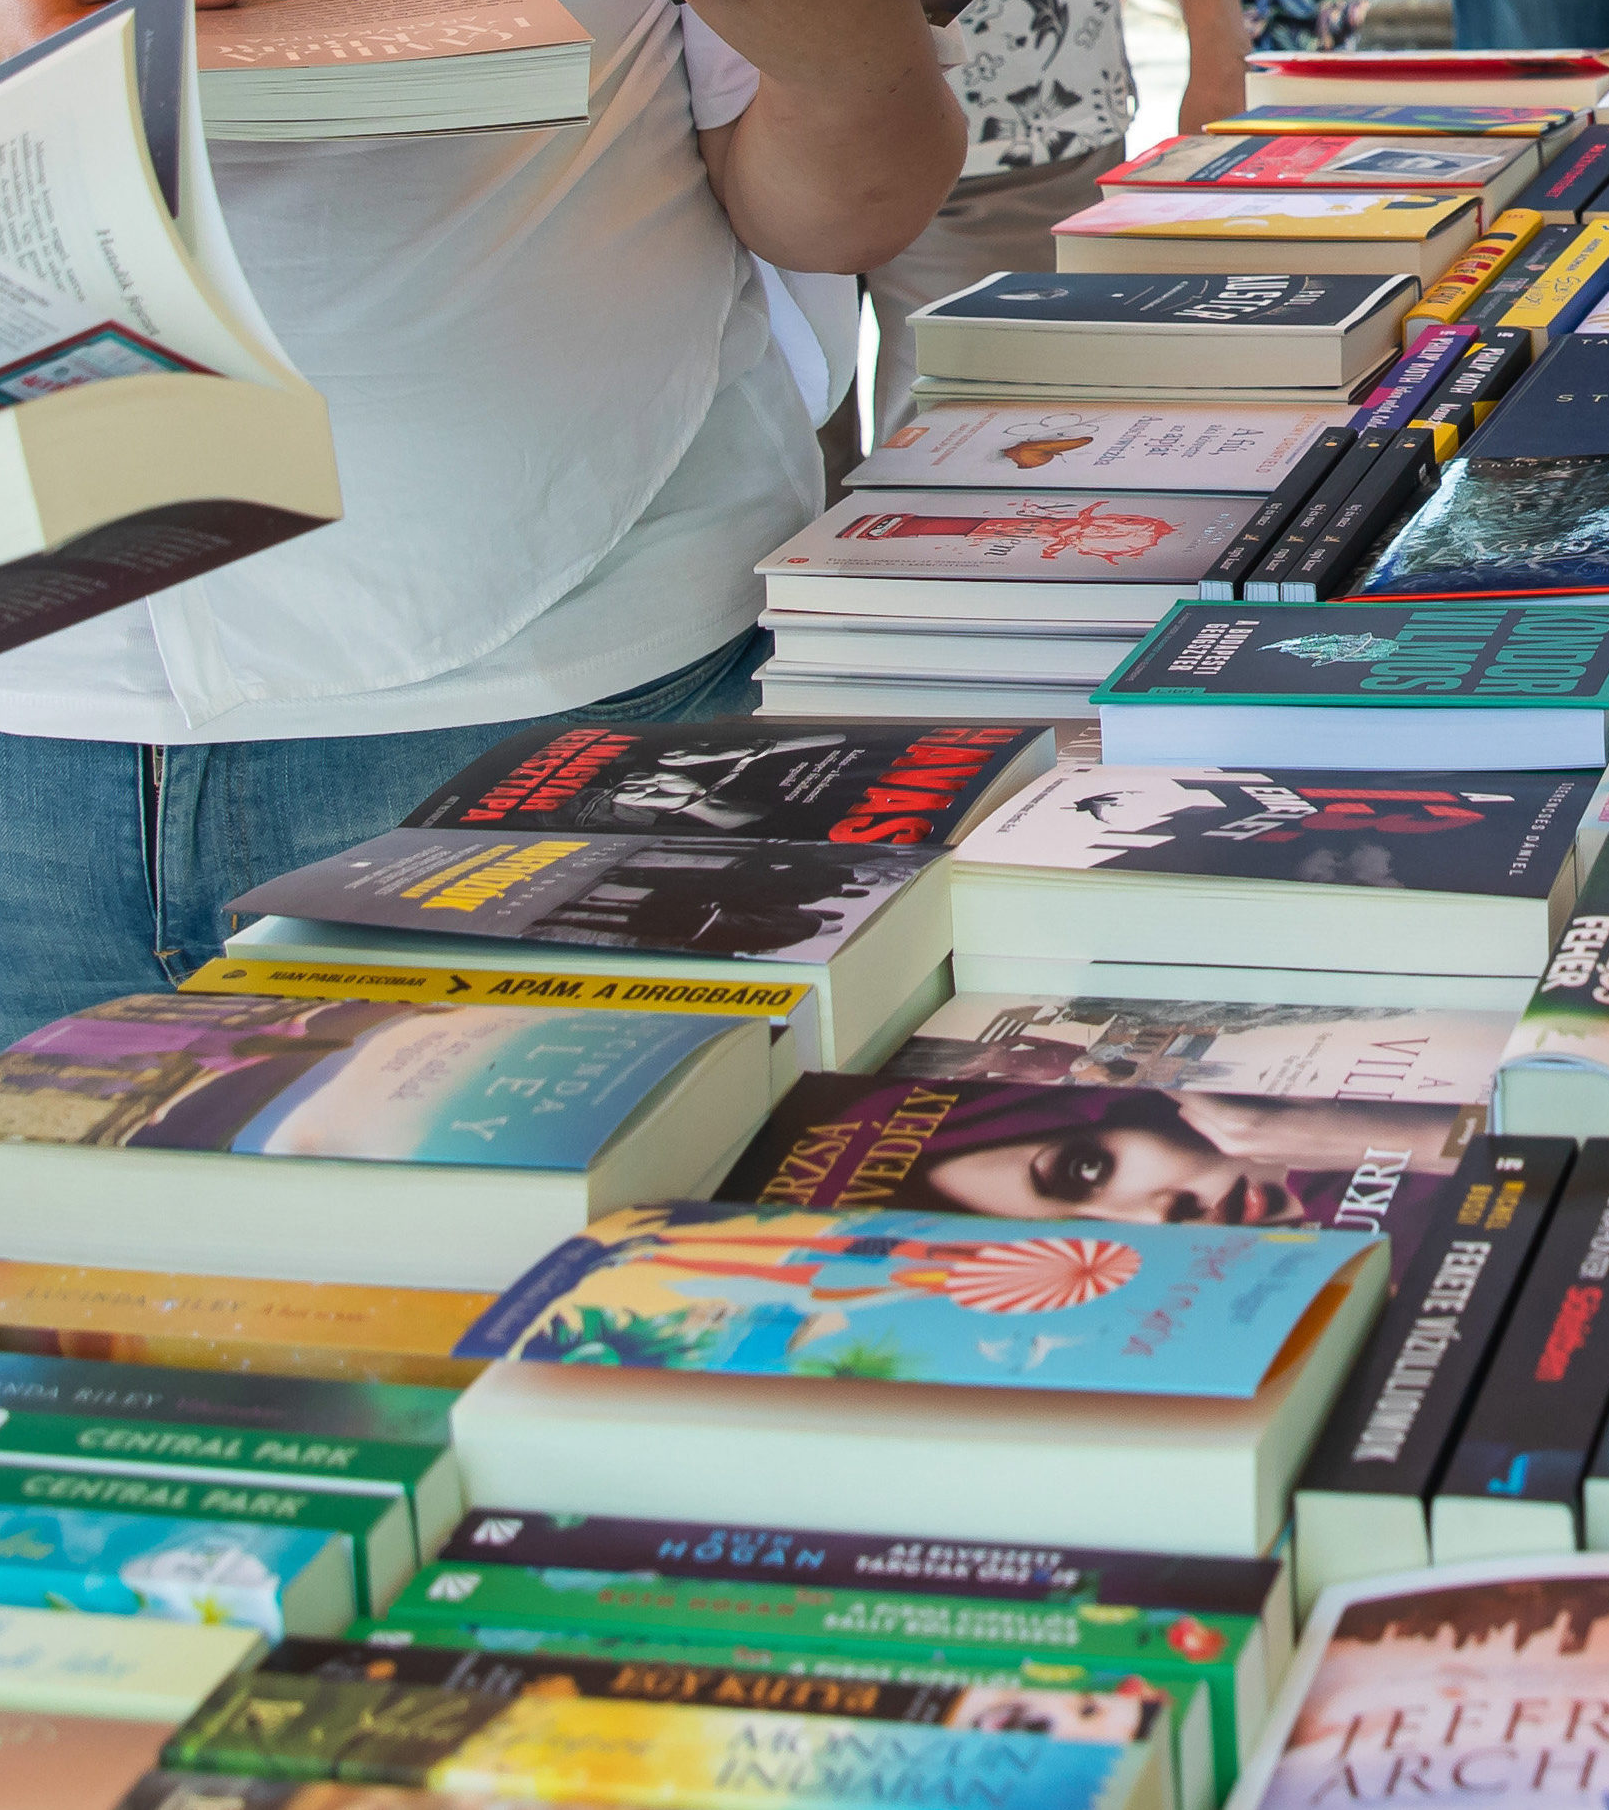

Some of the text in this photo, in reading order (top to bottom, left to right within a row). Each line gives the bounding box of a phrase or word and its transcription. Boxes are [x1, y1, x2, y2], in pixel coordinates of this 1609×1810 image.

[1167, 622, 1230, 673] GENGSZTER
[1193, 627, 1249, 676] BUDAPESTI
[1359, 608, 1509, 692] VILMOS
[519, 744, 631, 813] MAGYAR
[828, 727, 1024, 844] HAVAS
[594, 983, 614, 998] A
[1421, 1239, 1492, 1313] FEKETE
[76, 1426, 359, 1469] CENTRAL PARK
[21, 1475, 310, 1519] CENTRAL PARK
